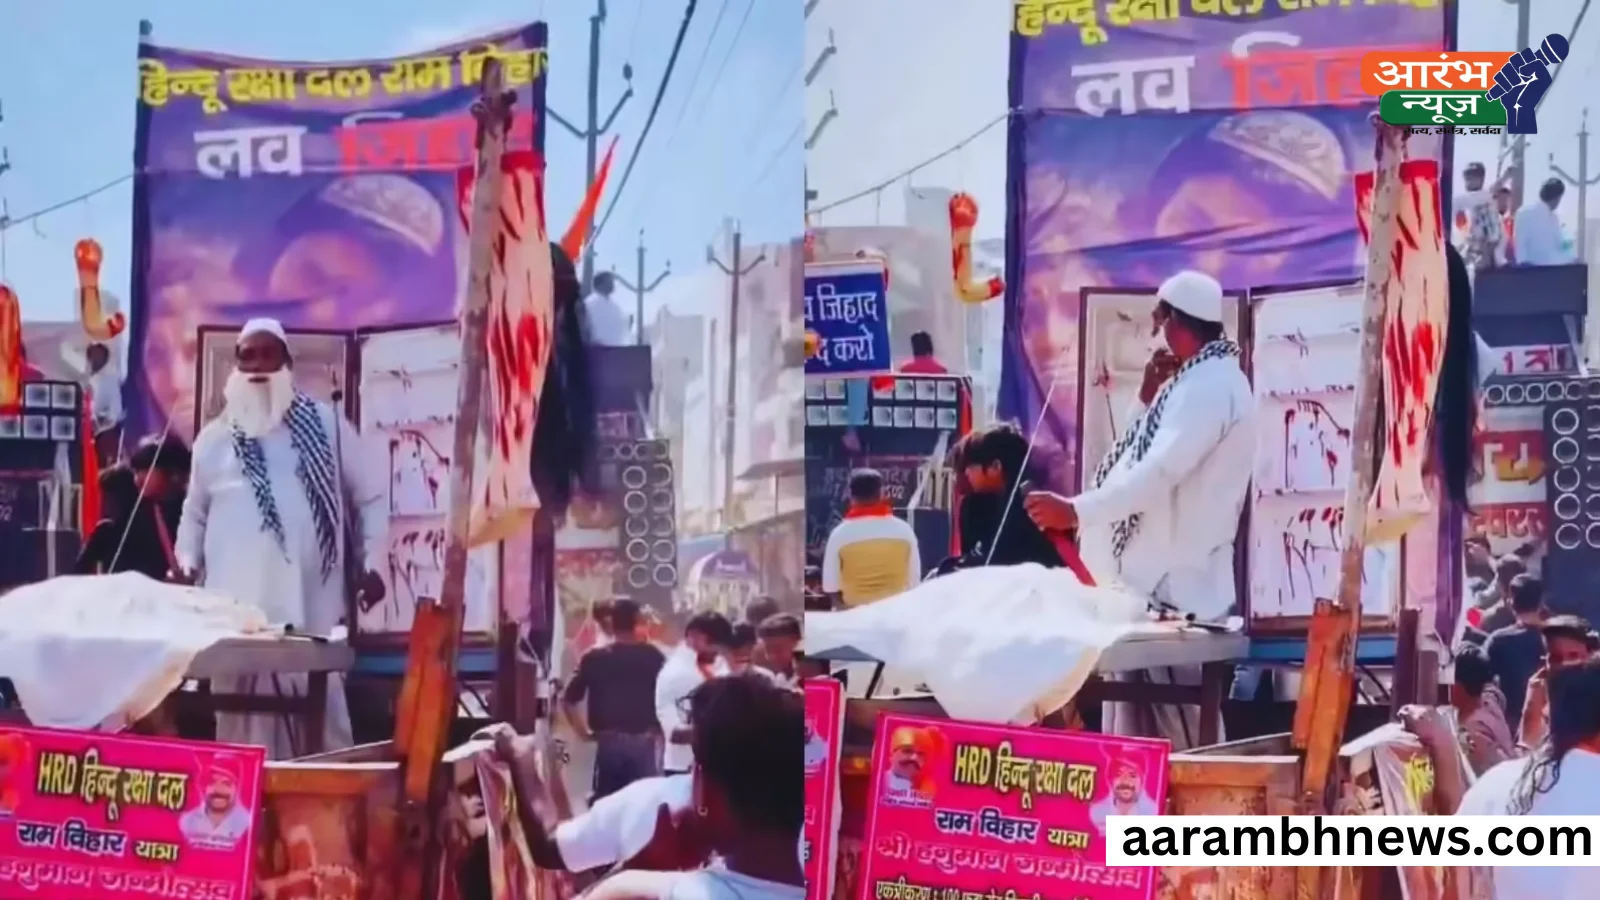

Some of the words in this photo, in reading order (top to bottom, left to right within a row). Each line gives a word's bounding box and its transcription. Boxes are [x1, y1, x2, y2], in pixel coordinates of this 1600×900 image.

[380, 56, 452, 93] राम
[1071, 56, 1195, 117] लव
[193, 126, 307, 179] लव
[817, 284, 879, 323] जिहाद
[832, 324, 875, 362] करो
[38, 752, 77, 794] HRD
[81, 748, 121, 820] हिन्दू
[123, 769, 153, 804] रक्षा
[157, 772, 189, 809] दल
[955, 745, 991, 785] HRD
[995, 741, 1034, 808] हिन्दू
[1034, 763, 1064, 793] रक्षा
[1067, 764, 1097, 800] दल
[18, 821, 60, 848] राम
[63, 818, 127, 857] विहार
[135, 840, 179, 861] यात्रा
[935, 808, 973, 833] राम
[980, 806, 1039, 842] विहार
[1047, 827, 1089, 848] यात्रा
